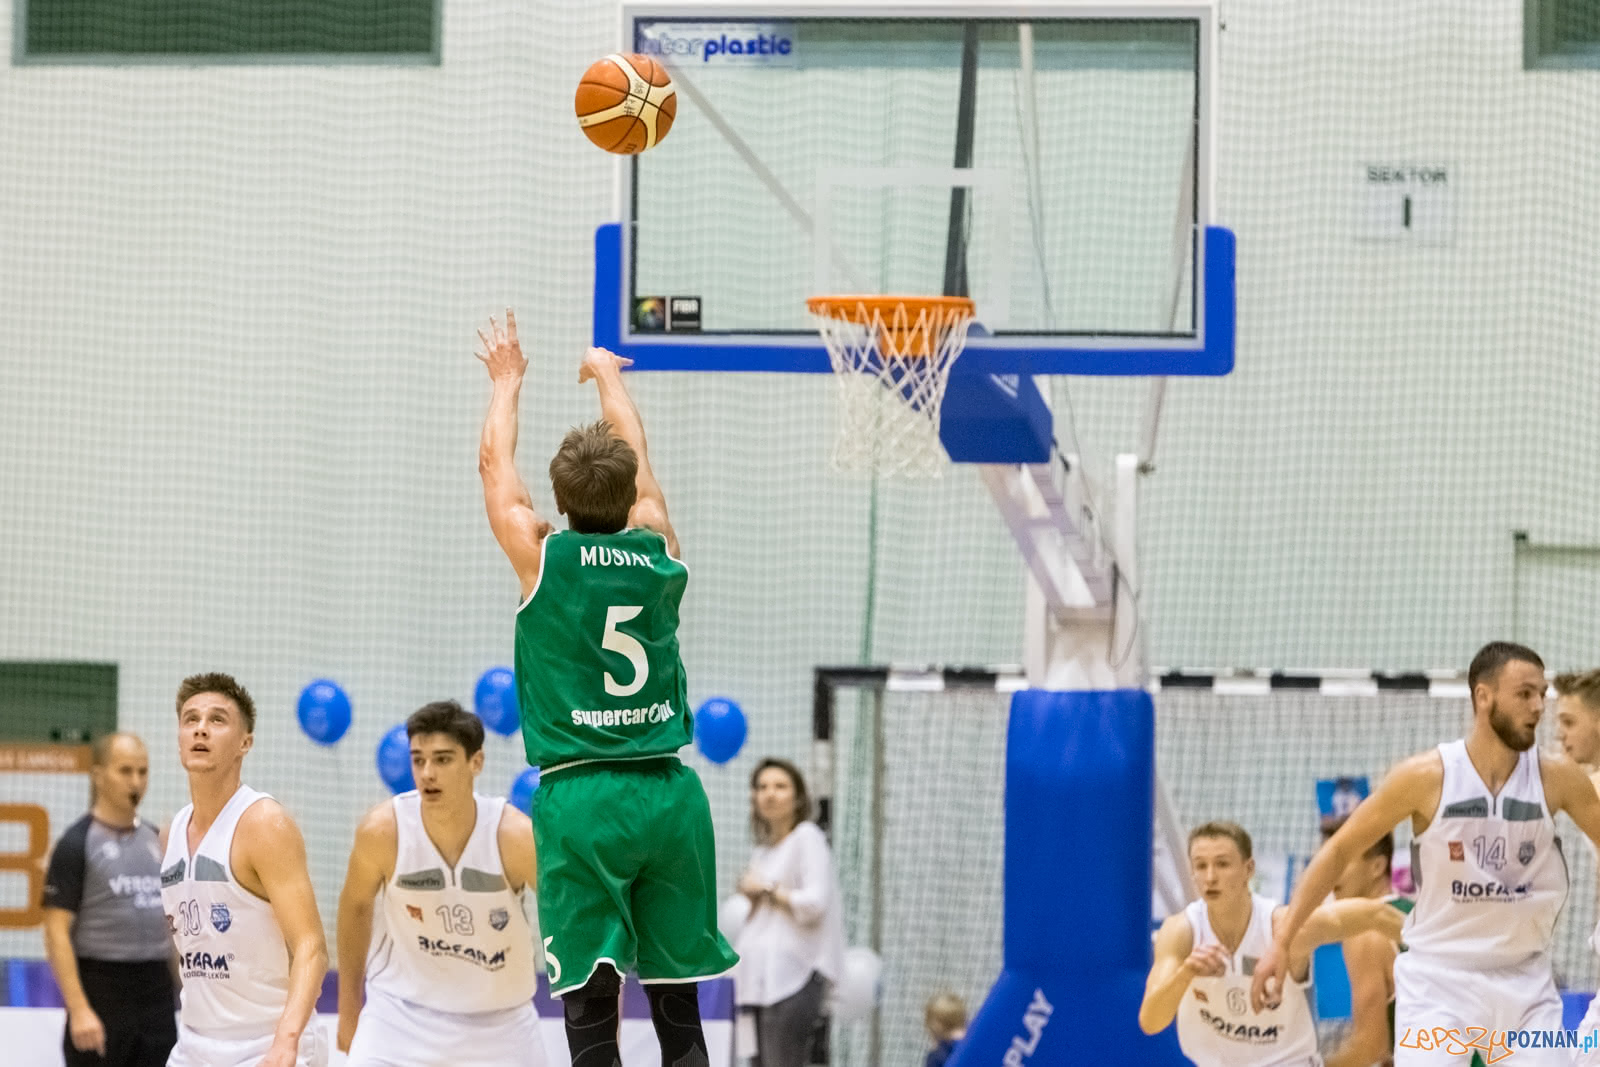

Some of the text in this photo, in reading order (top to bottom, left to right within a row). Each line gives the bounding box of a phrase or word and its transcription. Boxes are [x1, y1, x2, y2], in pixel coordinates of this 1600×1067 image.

[602, 605, 649, 697] 5
[1473, 835, 1507, 871] 14
[179, 899, 200, 936] 10
[436, 904, 475, 936] 13
